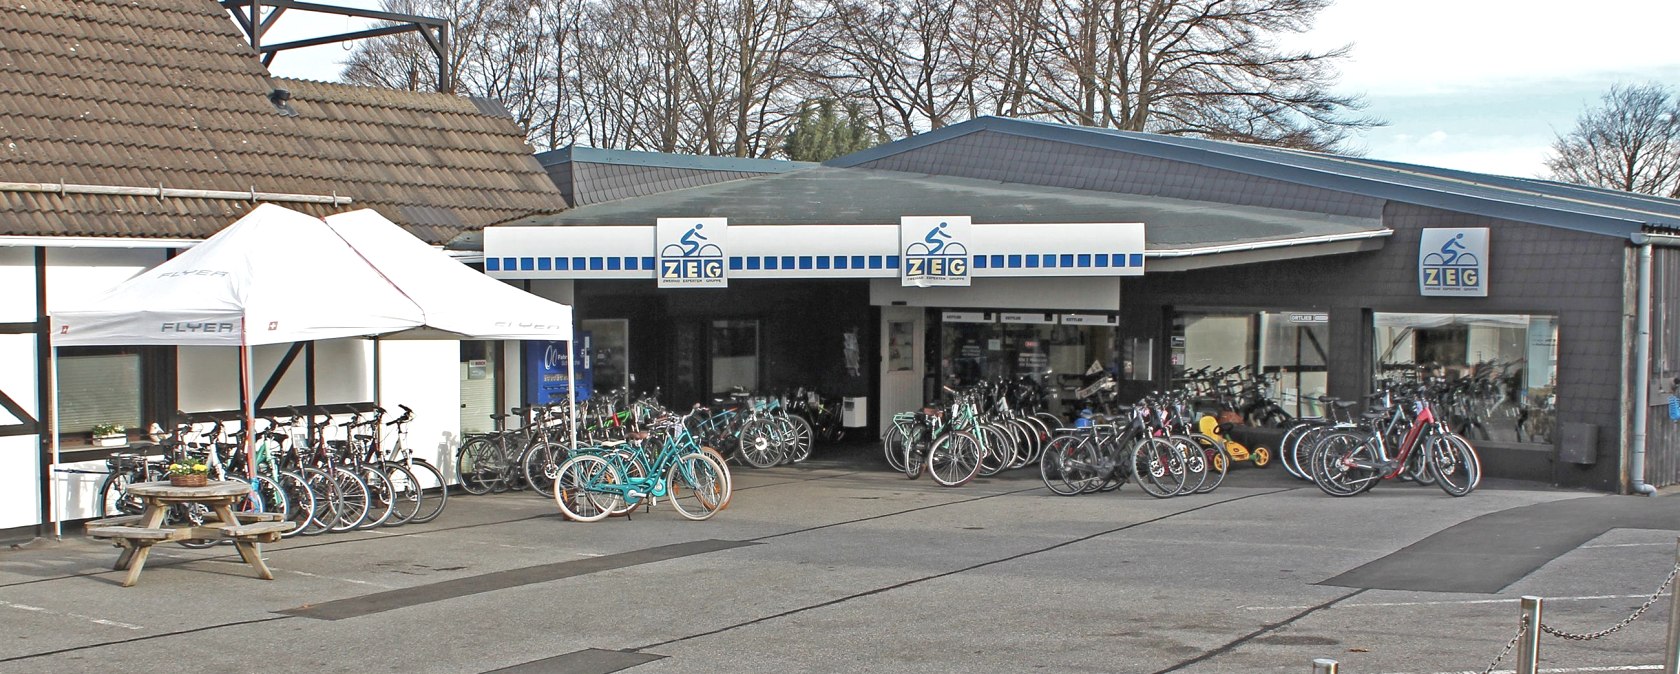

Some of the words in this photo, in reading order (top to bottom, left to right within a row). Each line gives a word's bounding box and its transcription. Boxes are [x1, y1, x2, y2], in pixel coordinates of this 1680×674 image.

[158, 269, 229, 278] FLYER
[664, 262, 722, 278] ZEG
[908, 259, 966, 275] ZEG
[1425, 269, 1478, 286] ZEG
[161, 323, 233, 332] FLYER
